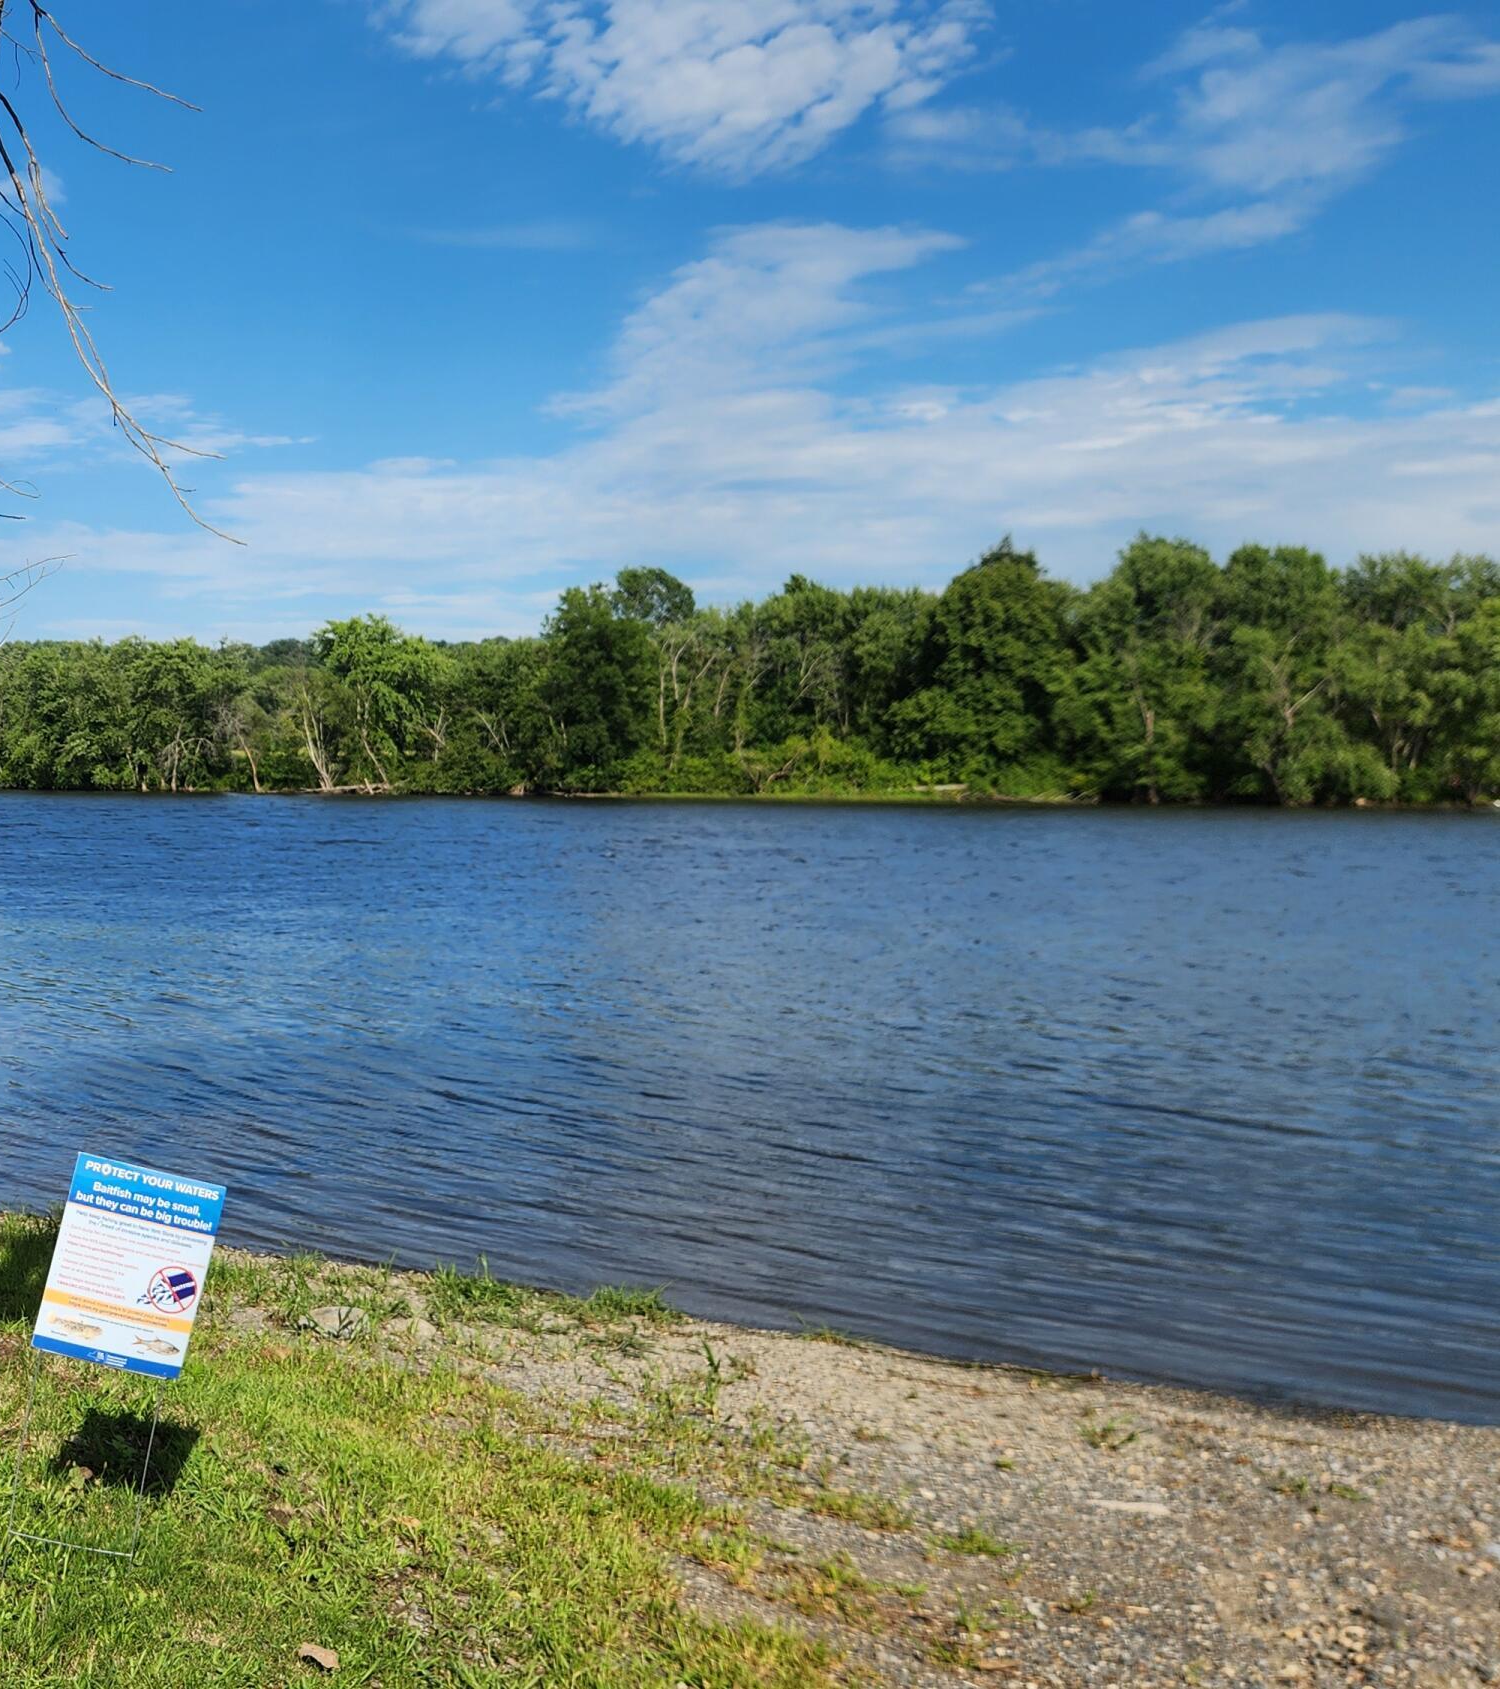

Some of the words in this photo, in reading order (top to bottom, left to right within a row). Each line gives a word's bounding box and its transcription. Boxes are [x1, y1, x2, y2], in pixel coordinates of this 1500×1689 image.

[84, 1160, 140, 1183] PROTECT
[142, 1174, 173, 1191] YOUR
[175, 1181, 220, 1201] WATERS
[93, 1181, 132, 1199] Baitfish
[133, 1191, 156, 1207] may
[157, 1197, 171, 1209] be
[172, 1200, 201, 1217] small,
[75, 1190, 94, 1204] but
[95, 1195, 119, 1211] they
[119, 1201, 139, 1214] can
[140, 1205, 154, 1218] be
[155, 1209, 172, 1225] big
[173, 1213, 213, 1232] trouble!
